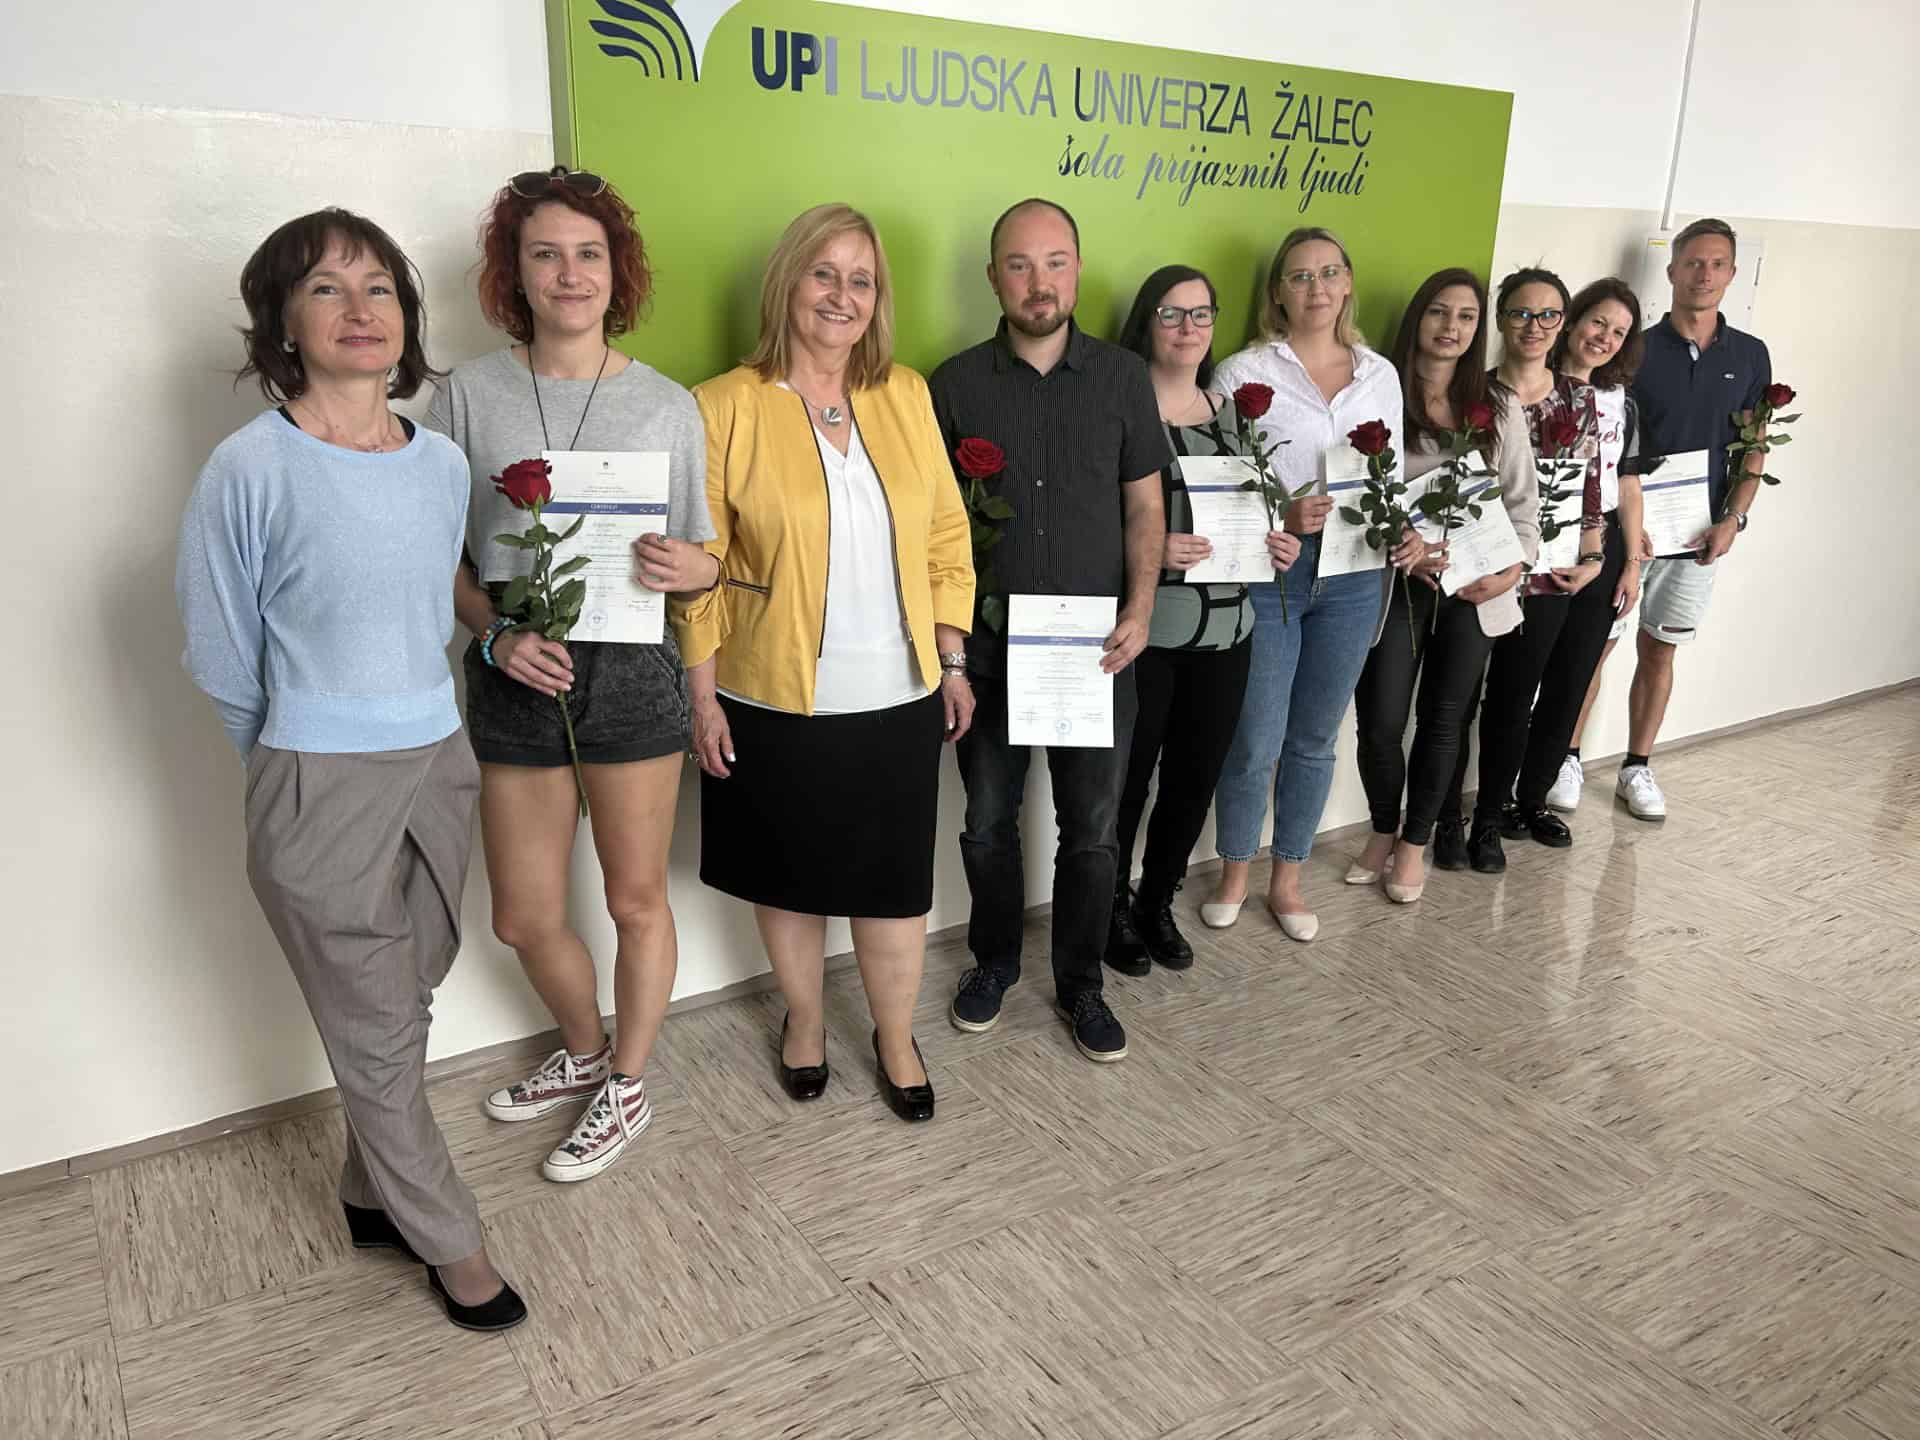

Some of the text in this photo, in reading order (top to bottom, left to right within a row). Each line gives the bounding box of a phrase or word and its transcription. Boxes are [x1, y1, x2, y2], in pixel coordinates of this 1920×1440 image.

[861, 41, 1057, 117] LJUDSKA
[1074, 67, 1251, 135] UNIVERZA
[1270, 81, 1373, 147] ŽALEC
[1058, 134, 1371, 213] šola prijaznih ljudi
